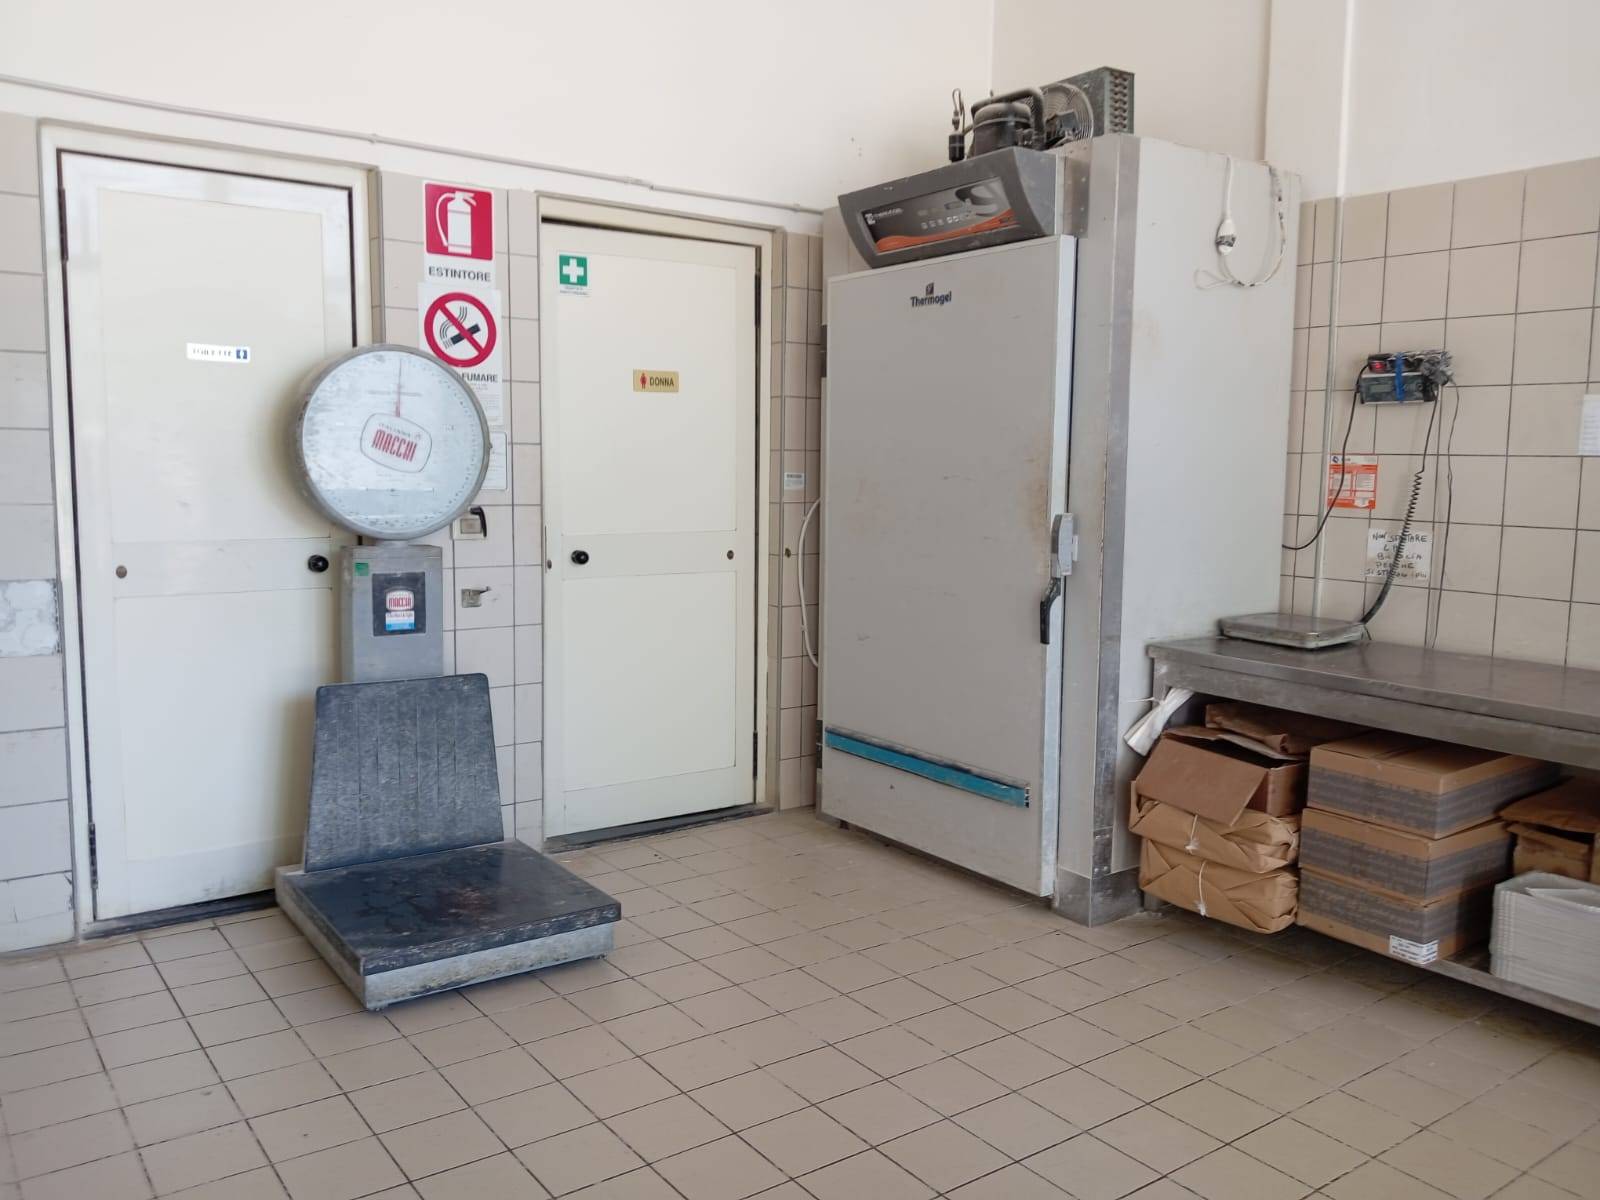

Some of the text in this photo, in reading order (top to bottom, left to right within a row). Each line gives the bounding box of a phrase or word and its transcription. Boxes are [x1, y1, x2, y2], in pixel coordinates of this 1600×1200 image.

[428, 265, 492, 282] ESTINTORE
[910, 290, 952, 307] Thermogel
[649, 376, 675, 387] DONNA
[371, 428, 417, 462] MACCHI
